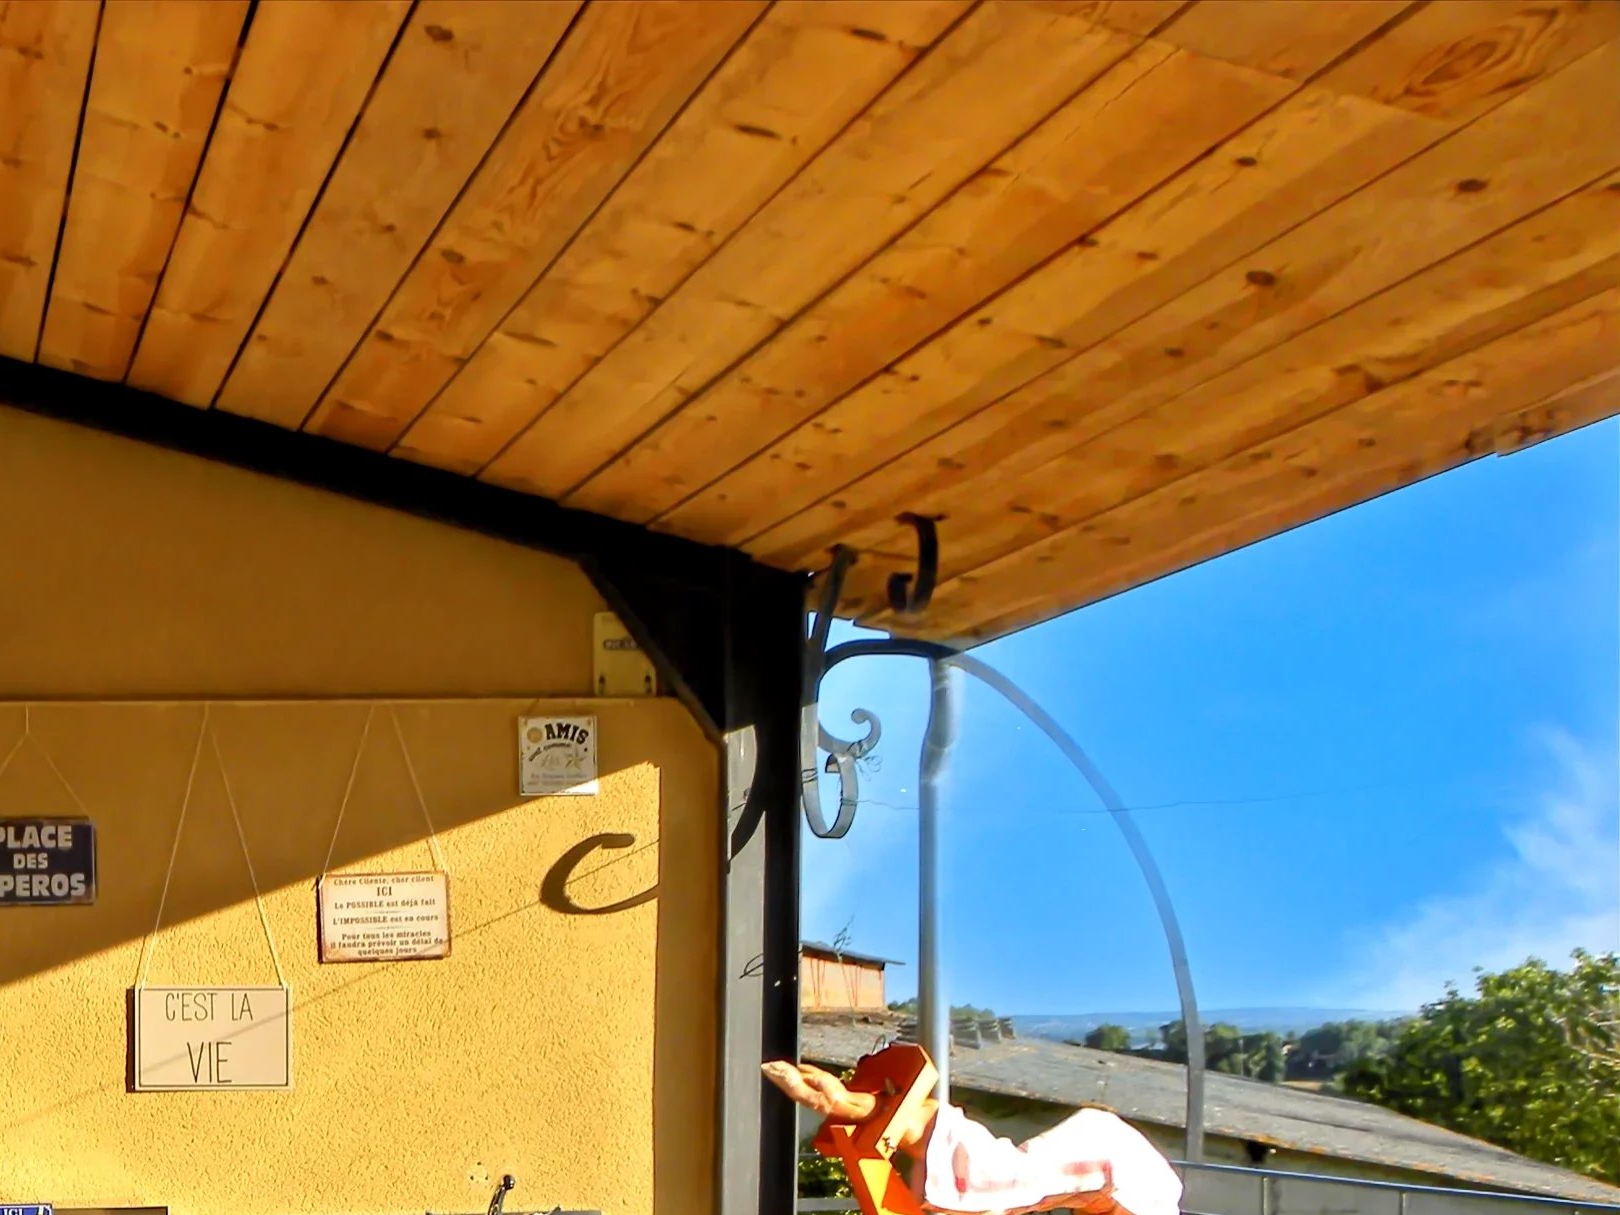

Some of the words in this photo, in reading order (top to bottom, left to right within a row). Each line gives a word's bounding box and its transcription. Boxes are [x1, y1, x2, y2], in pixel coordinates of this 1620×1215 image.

[545, 722, 589, 744] AMIS
[12, 852, 49, 869] DES
[376, 886, 393, 896] ICI
[346, 900, 385, 909] POSSIBLE
[386, 900, 399, 908] est
[420, 898, 436, 906] fait
[332, 915, 388, 925] L'IMPOSSIBLE
[390, 915, 402, 923] est
[341, 933, 360, 941] Pour
[382, 930, 395, 938] les
[165, 992, 218, 1022] C'EST
[231, 993, 254, 1021] LA
[186, 1041, 233, 1084] VIE
